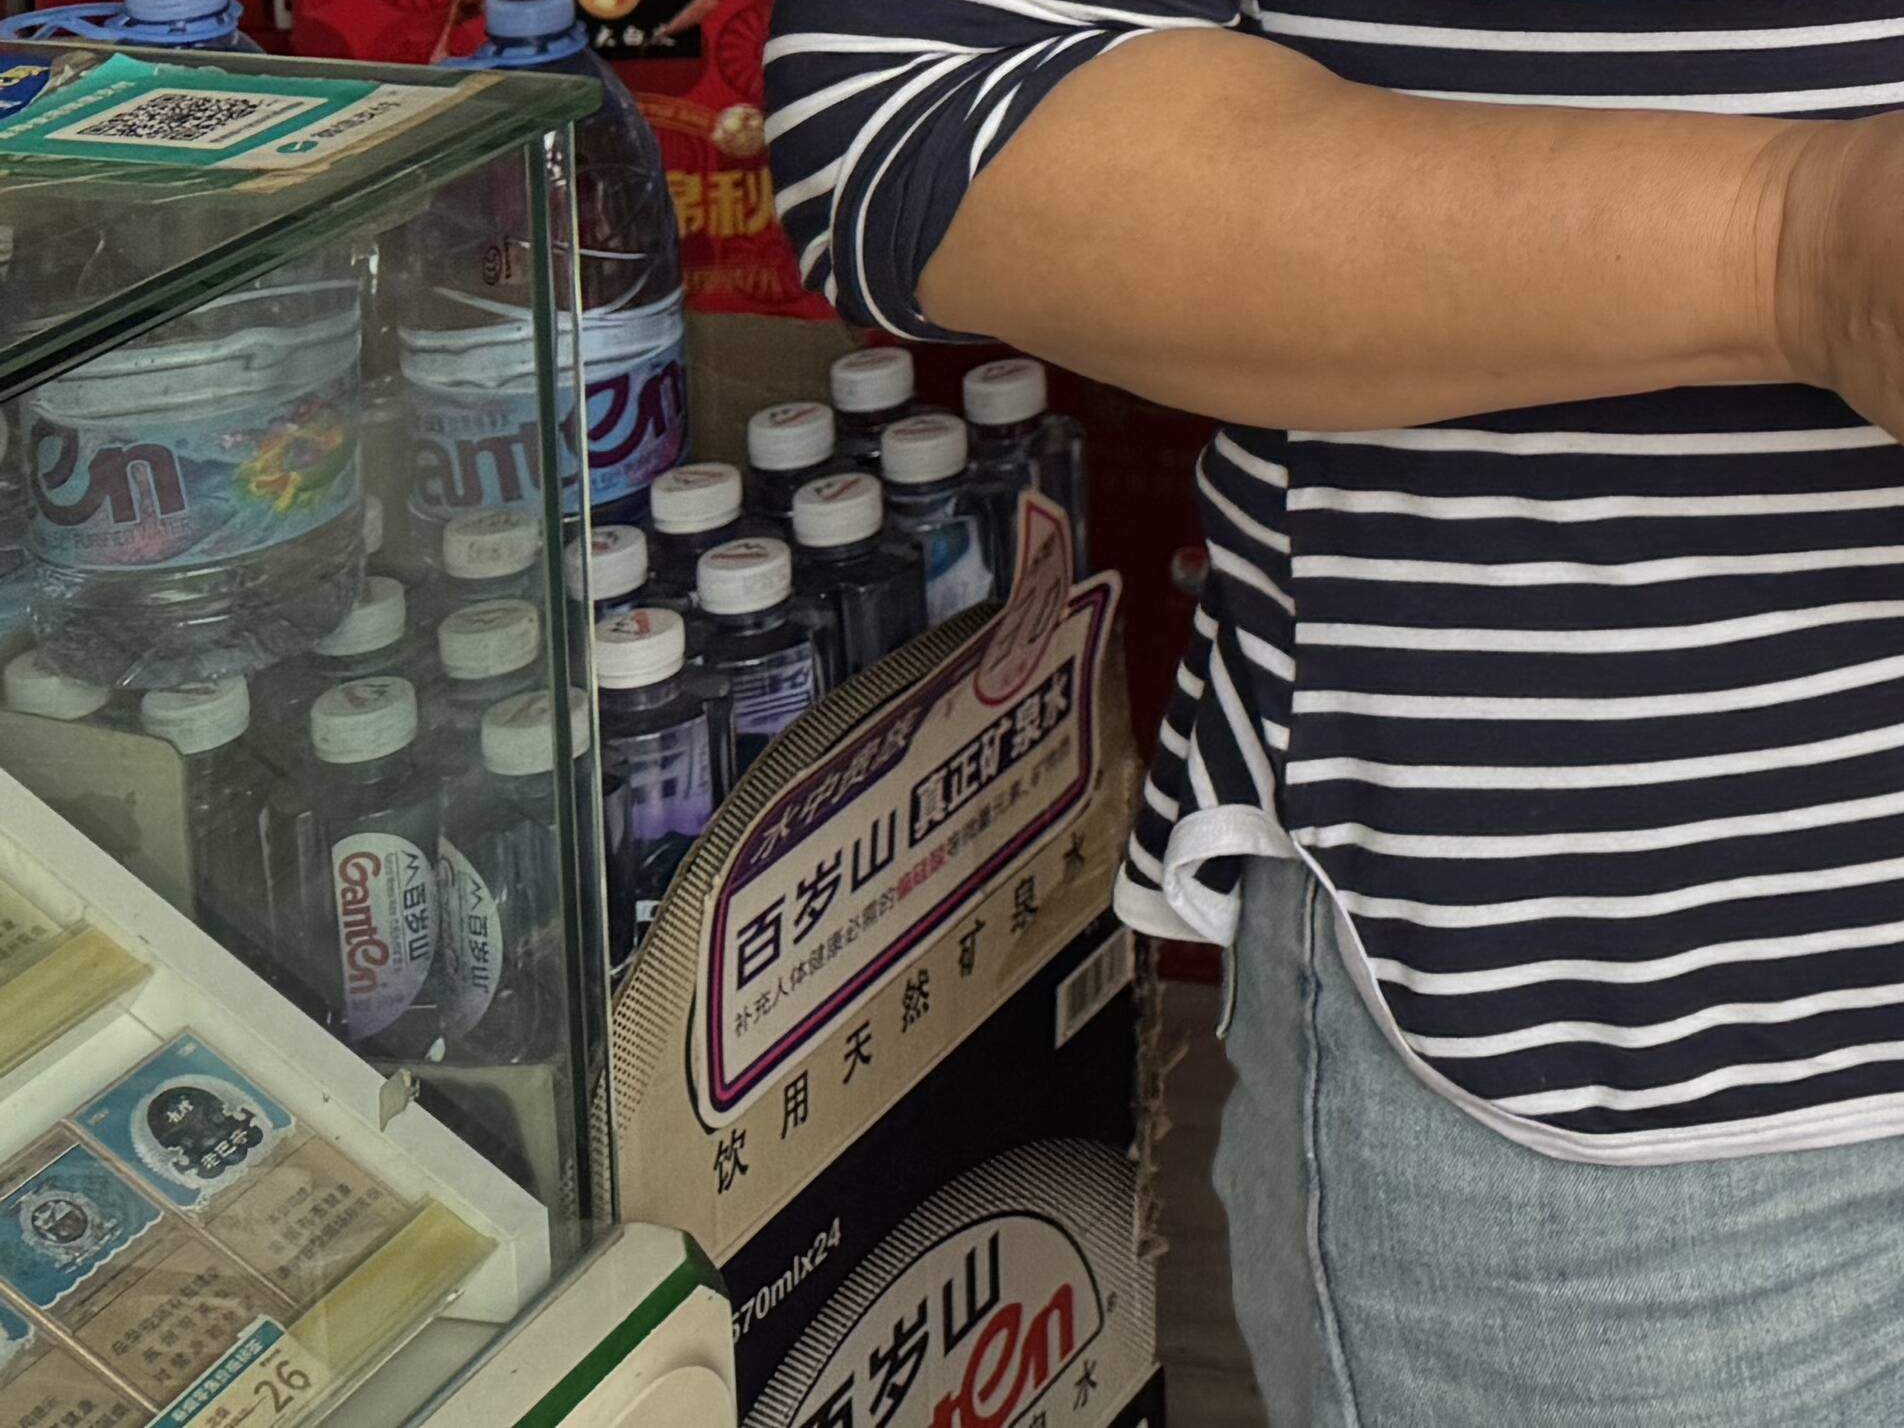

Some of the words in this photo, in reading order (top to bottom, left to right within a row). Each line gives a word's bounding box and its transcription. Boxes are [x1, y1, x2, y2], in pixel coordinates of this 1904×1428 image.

[736, 808, 898, 991] 百岁山
[713, 832, 1087, 1194] 饮用天然矿泉水
[253, 1357, 313, 1414] 26
